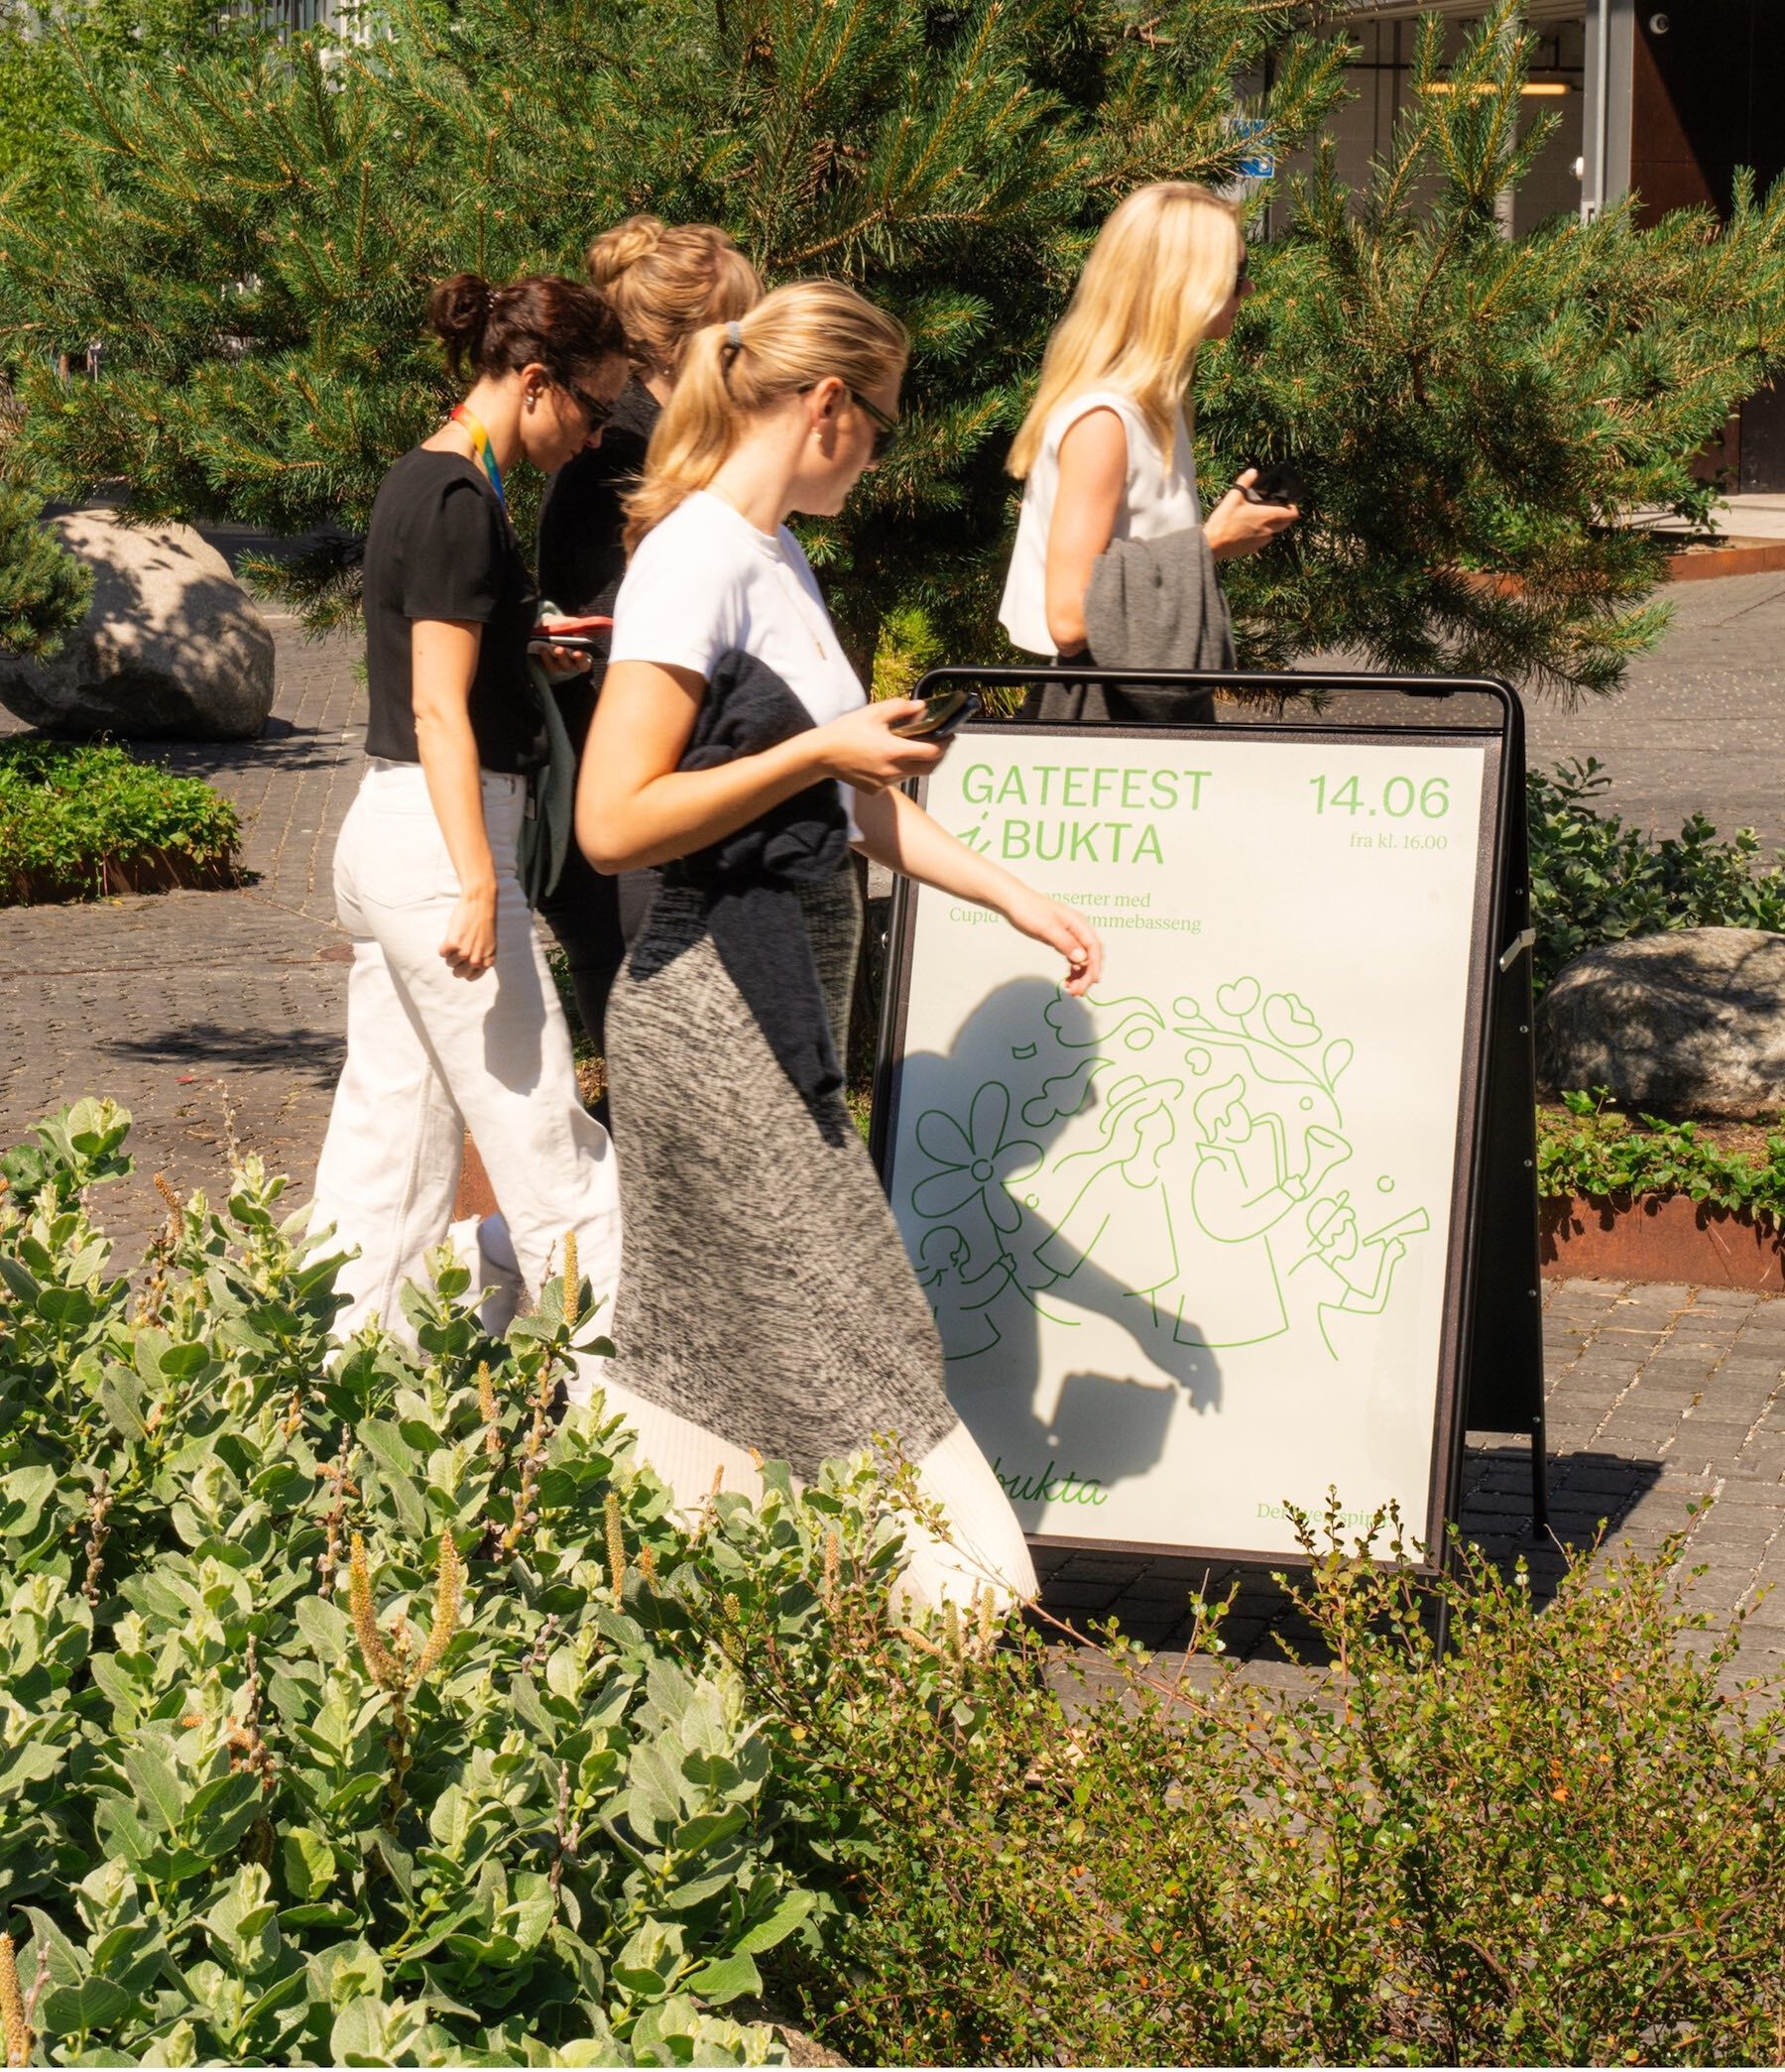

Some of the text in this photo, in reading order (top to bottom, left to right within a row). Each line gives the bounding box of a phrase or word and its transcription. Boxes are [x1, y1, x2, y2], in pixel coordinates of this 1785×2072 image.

[962, 763, 1213, 810] GATEFEST
[1309, 774, 1450, 818] 14.06
[1002, 819, 1164, 864] BUKTA
[1350, 831, 1448, 850] fra kl. 16.00
[1115, 892, 1151, 908] med
[1087, 913, 1203, 934] mmebasseng
